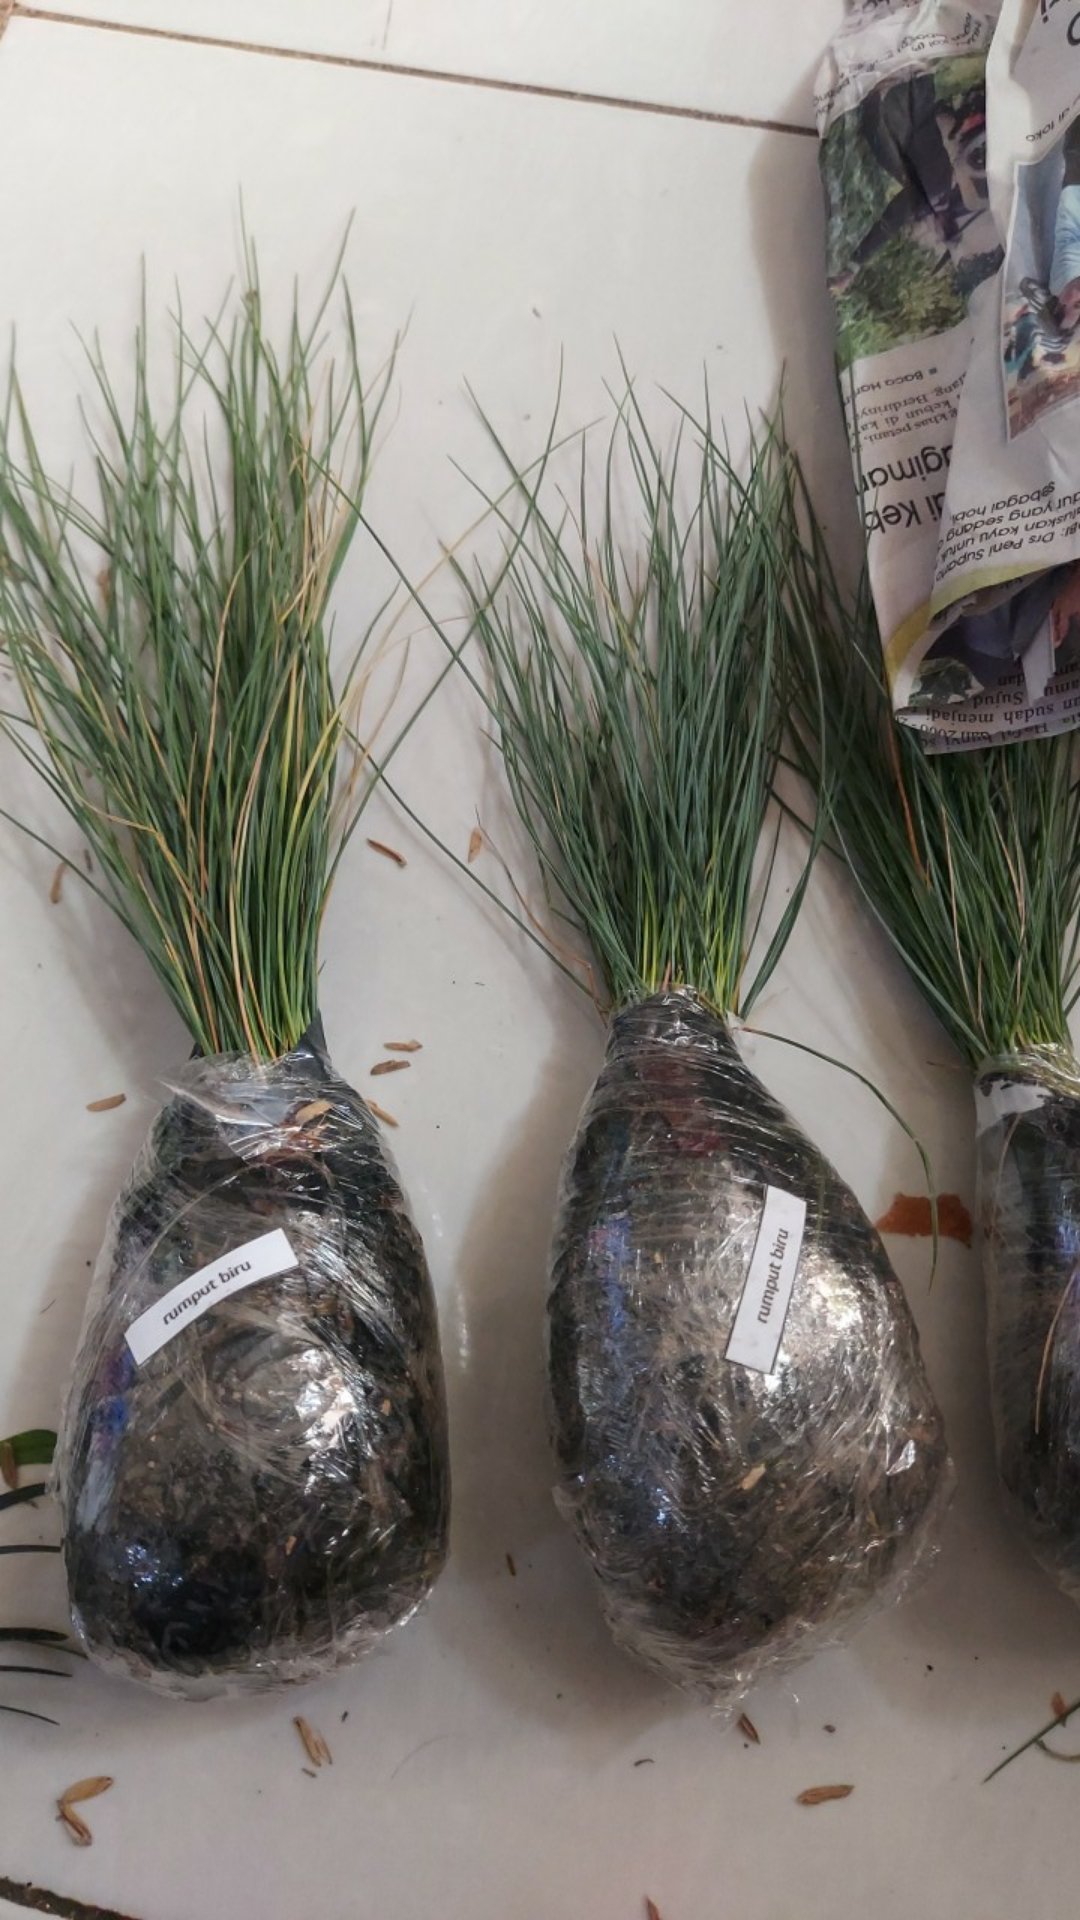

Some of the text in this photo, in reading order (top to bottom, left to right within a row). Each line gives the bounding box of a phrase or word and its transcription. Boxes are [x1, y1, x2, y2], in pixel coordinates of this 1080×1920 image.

[905, 399, 952, 419] kebun
[885, 415, 899, 427] di
[914, 413, 948, 430] khas
[1008, 500, 1053, 522] yang
[946, 516, 1004, 541] sedang
[979, 525, 1019, 543] kayu
[1028, 531, 1055, 544] Drs
[973, 691, 1024, 709] Sujud
[926, 708, 994, 726] menjadi
[1004, 704, 1054, 725] sudah
[757, 1229, 789, 1324] rumput biru
[163, 1260, 252, 1325] rumput biru
